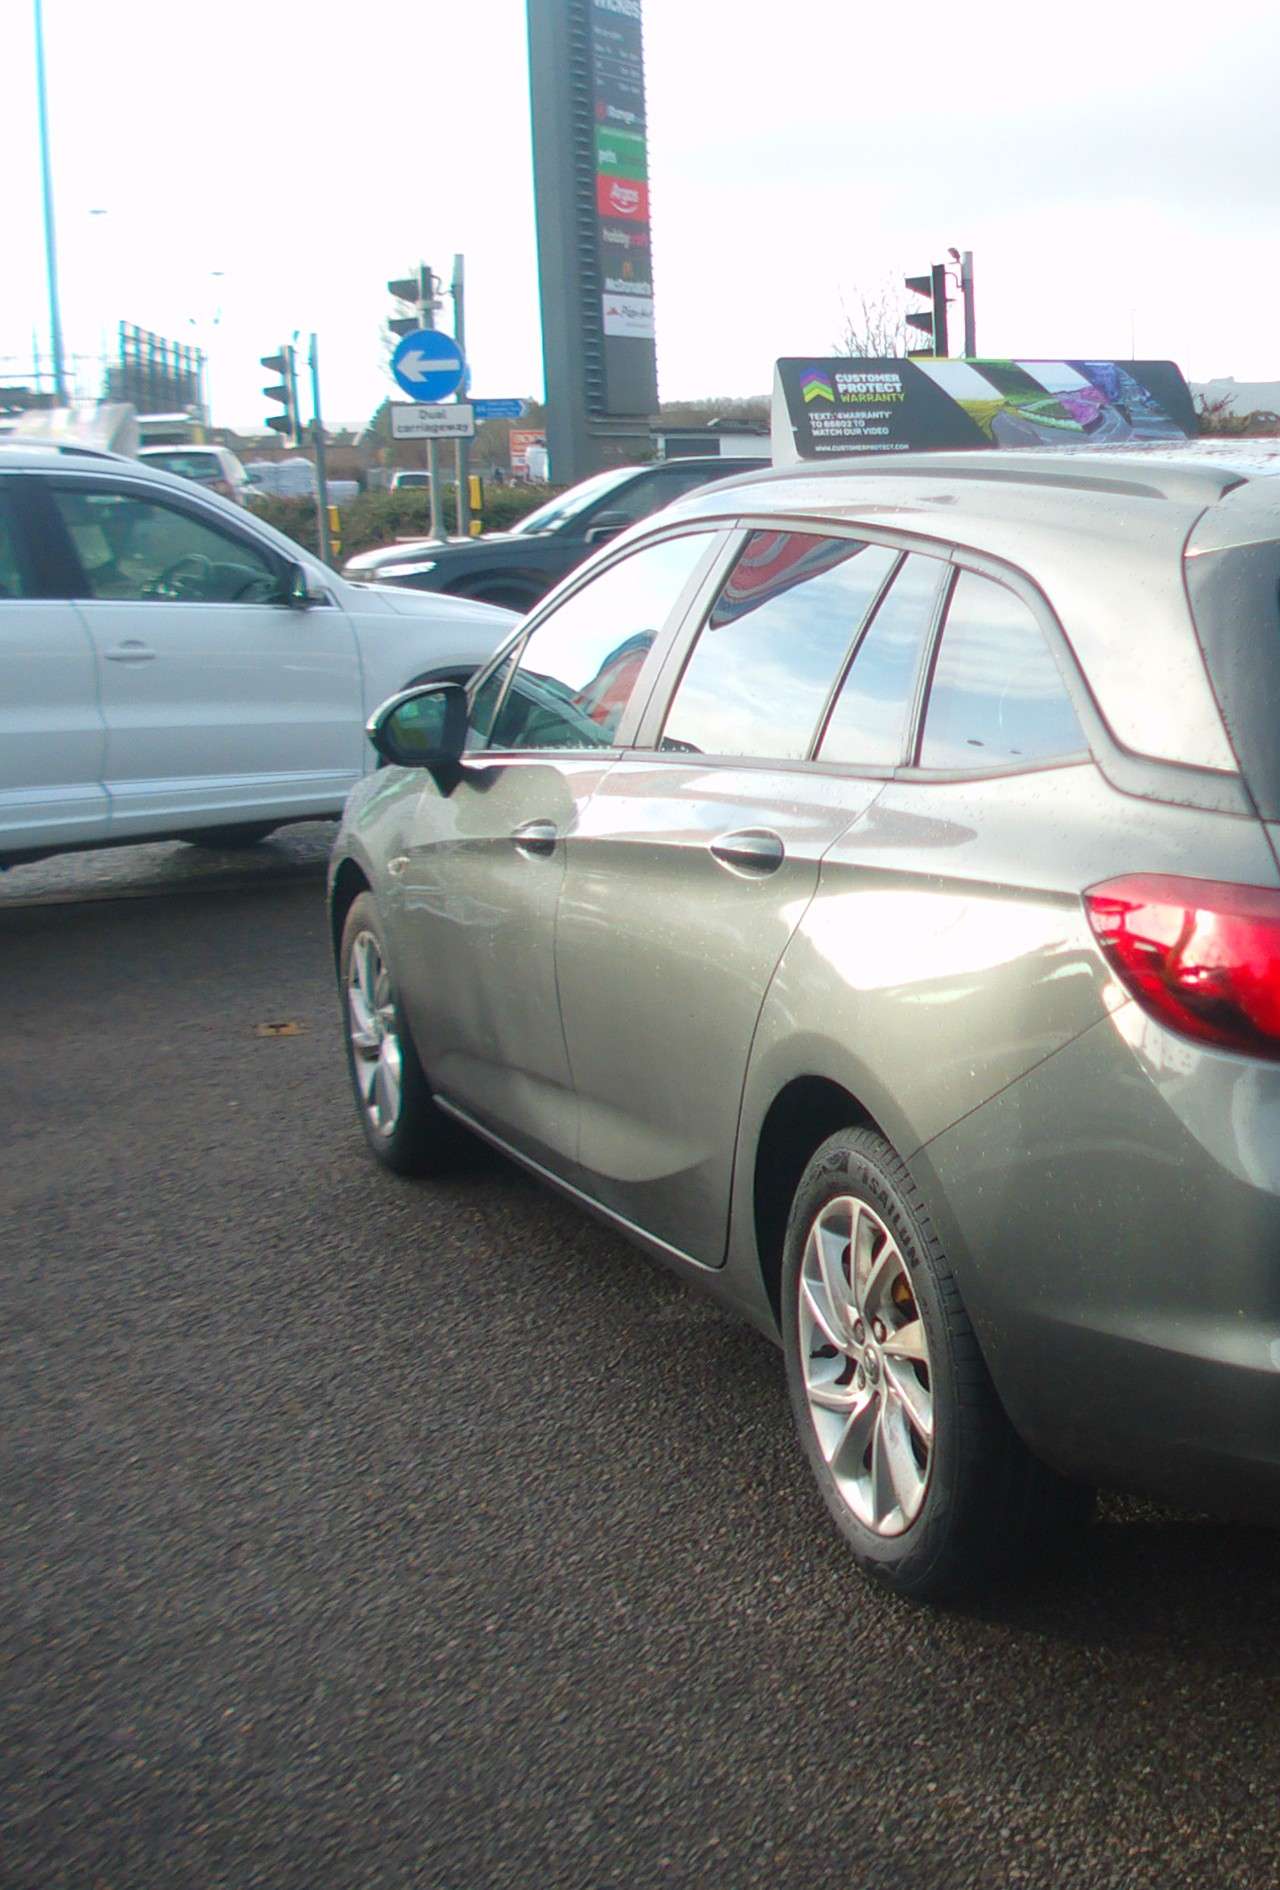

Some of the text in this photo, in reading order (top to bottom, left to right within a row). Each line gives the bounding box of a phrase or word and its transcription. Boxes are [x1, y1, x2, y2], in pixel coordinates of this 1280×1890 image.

[835, 373, 900, 384] CUSTOMER
[837, 383, 903, 394] PROTECT
[840, 392, 905, 403] WARRANTY
[418, 409, 447, 421] Dual
[397, 422, 469, 434] carriageway
[812, 427, 889, 436] WATCH OUR VIDEO
